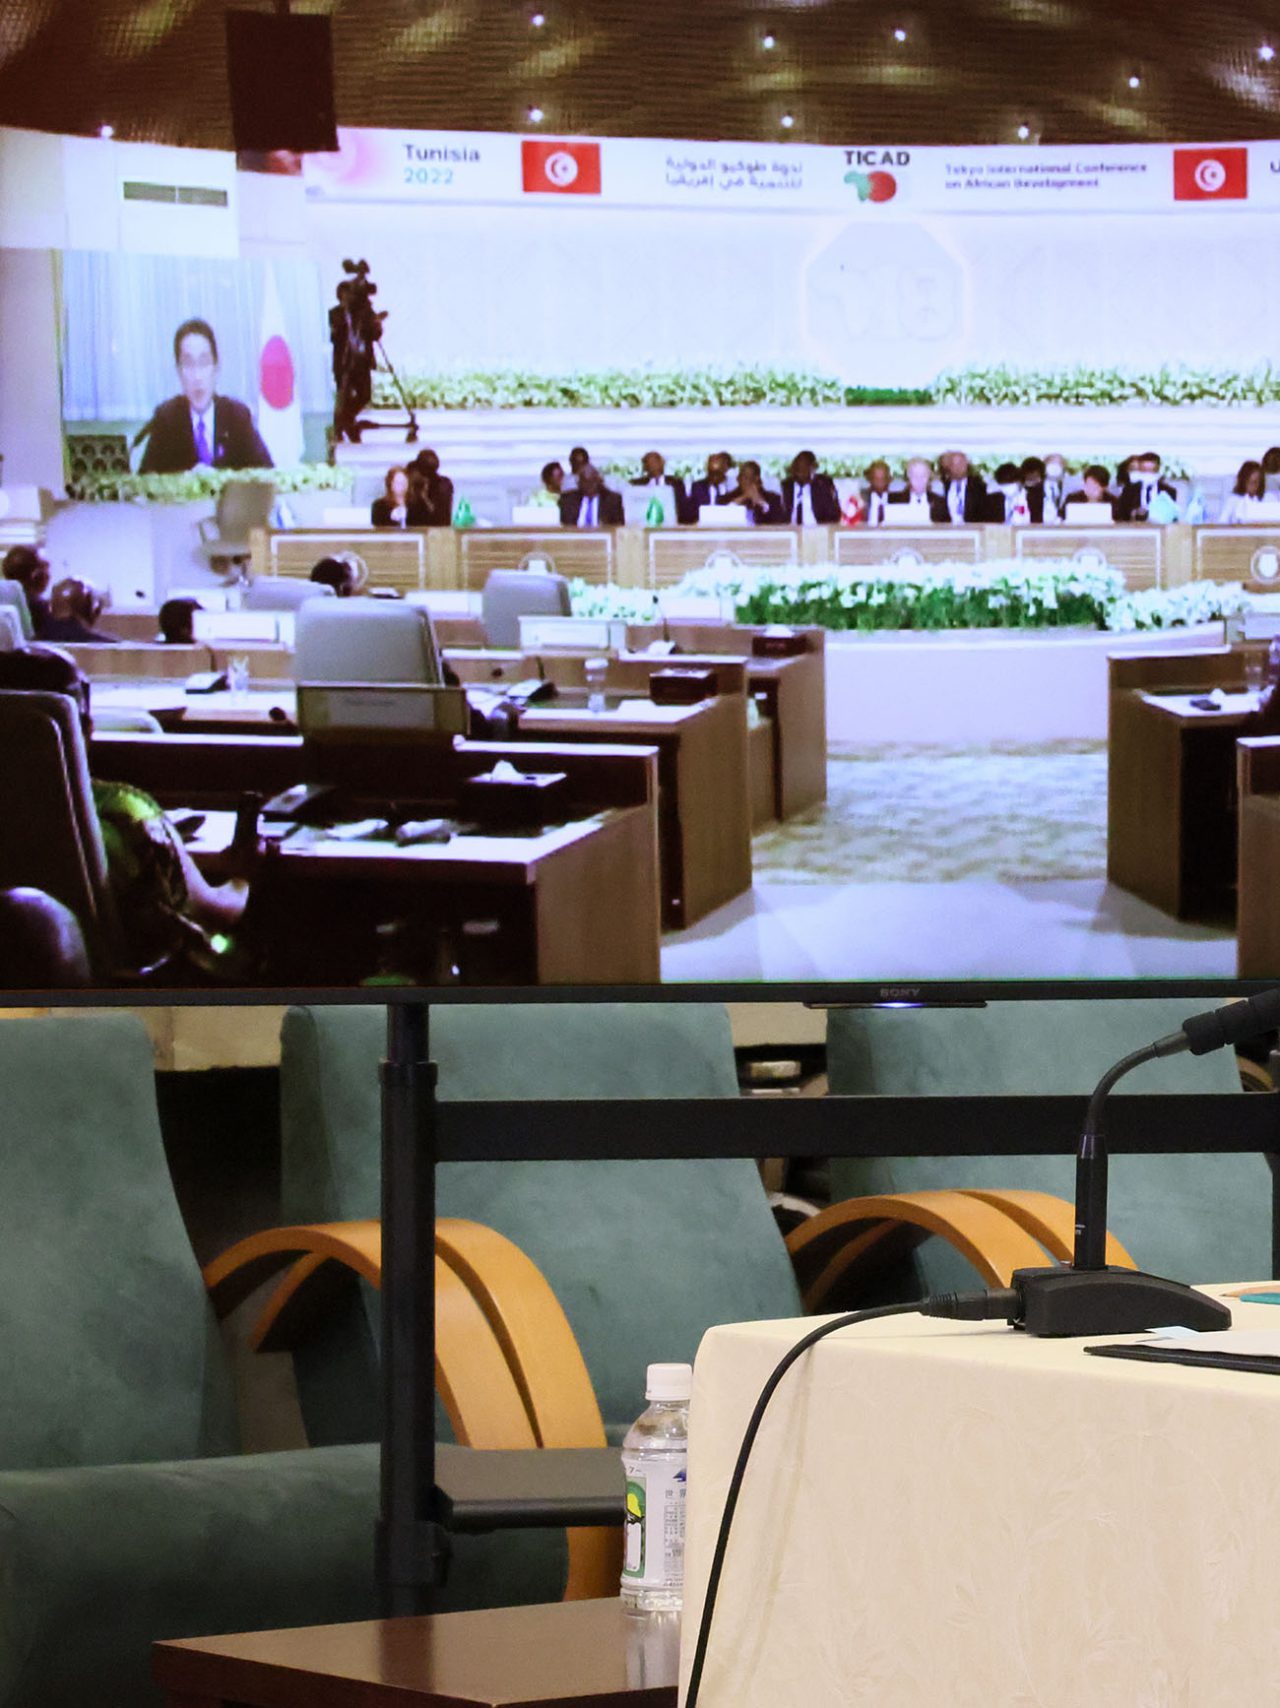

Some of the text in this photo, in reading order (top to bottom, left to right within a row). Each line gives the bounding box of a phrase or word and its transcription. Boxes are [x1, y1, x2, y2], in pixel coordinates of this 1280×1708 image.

[402, 144, 481, 161] Tunisia
[844, 150, 910, 166] TICAD
[403, 167, 454, 184] 2022
[880, 988, 920, 998] SONY
